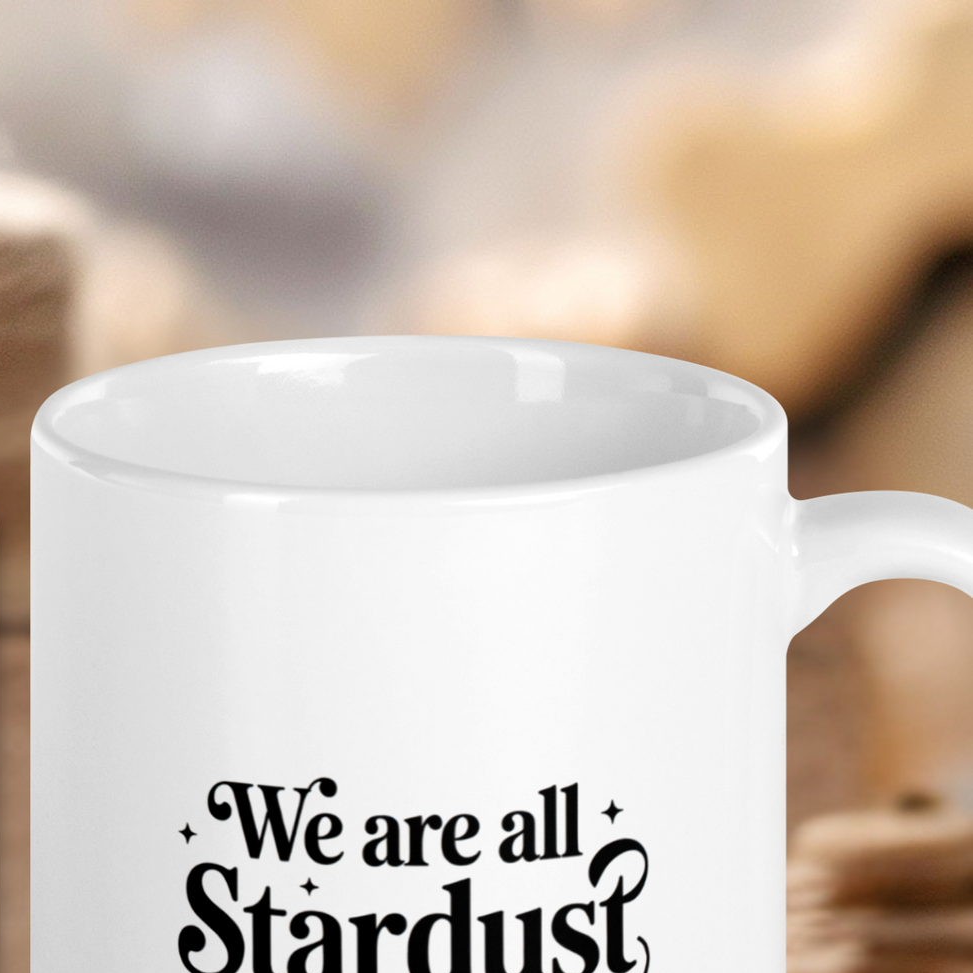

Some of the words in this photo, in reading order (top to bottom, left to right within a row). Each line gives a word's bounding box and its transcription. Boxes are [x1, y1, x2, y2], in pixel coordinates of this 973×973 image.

[207, 777, 344, 866] We
[362, 814, 482, 868] are
[498, 782, 584, 864] all
